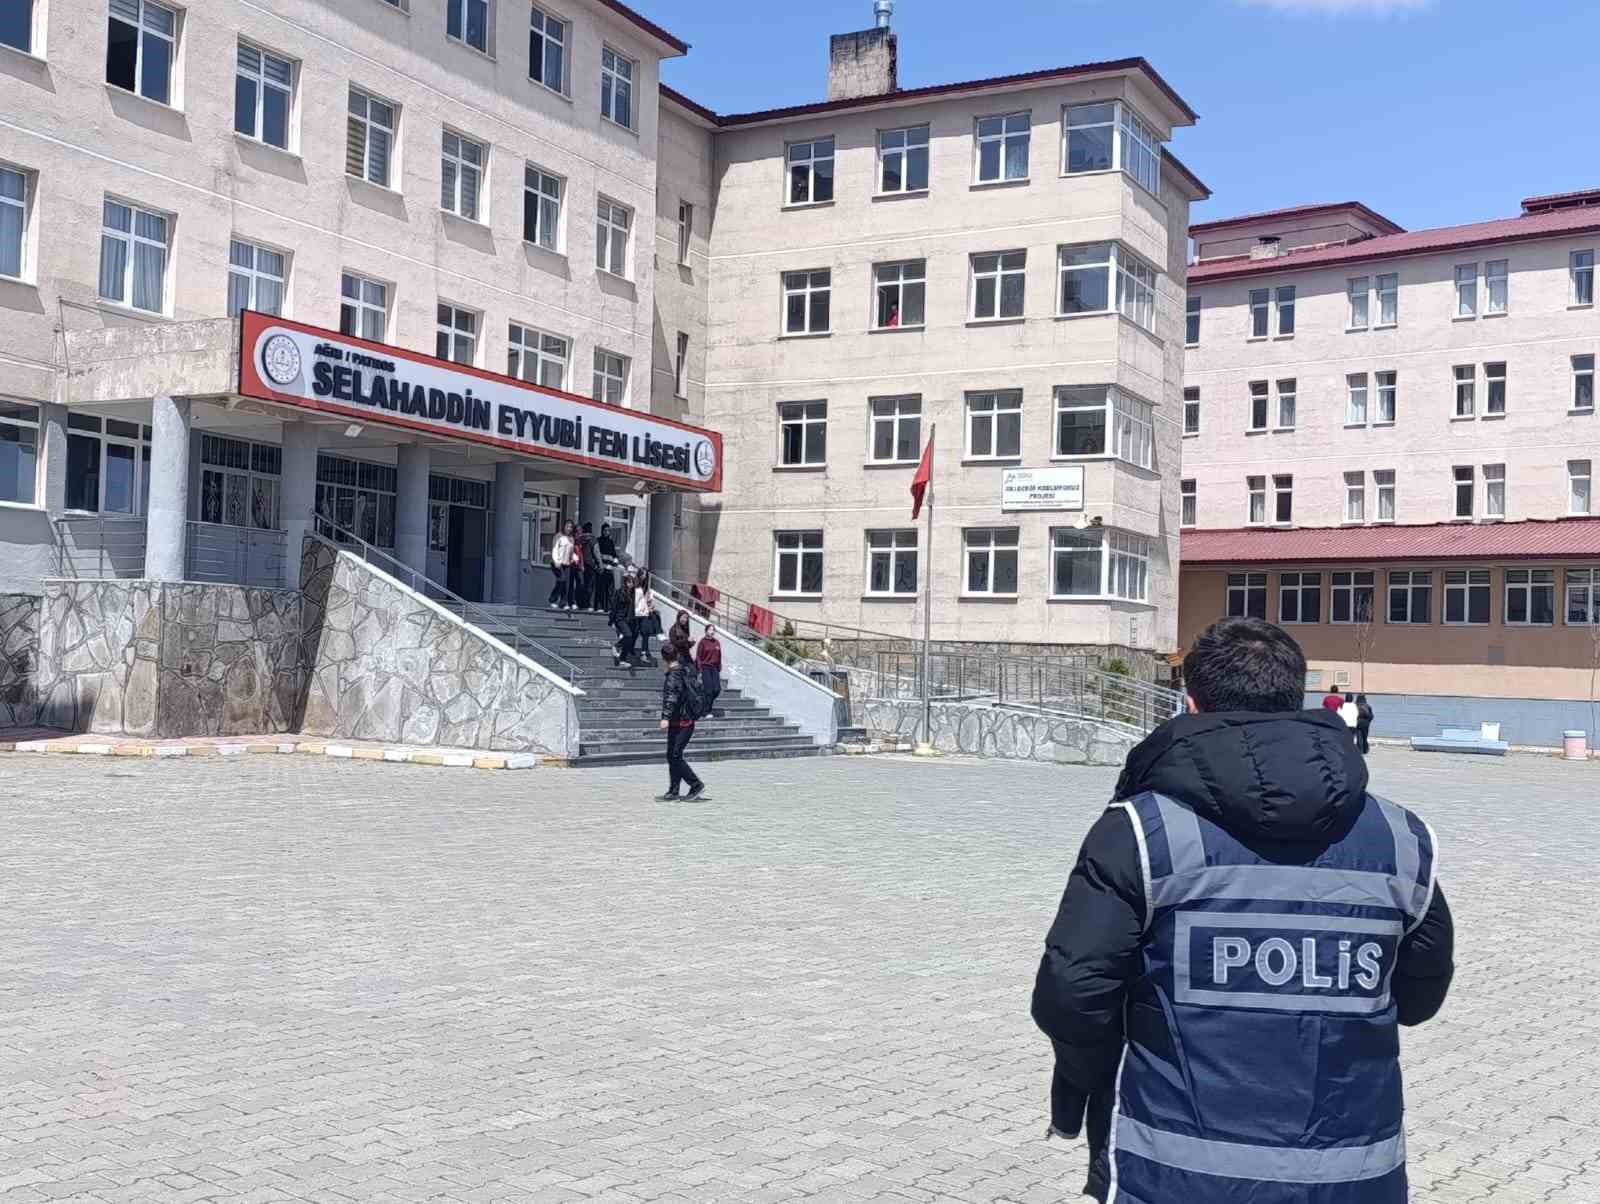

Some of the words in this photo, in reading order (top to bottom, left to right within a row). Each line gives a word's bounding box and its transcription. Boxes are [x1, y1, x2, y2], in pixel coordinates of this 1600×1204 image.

[312, 361, 491, 431] SELAHADDİN
[497, 404, 582, 450] EYYUBİ
[587, 425, 628, 460] FEN
[632, 432, 691, 473] LİSESİ
